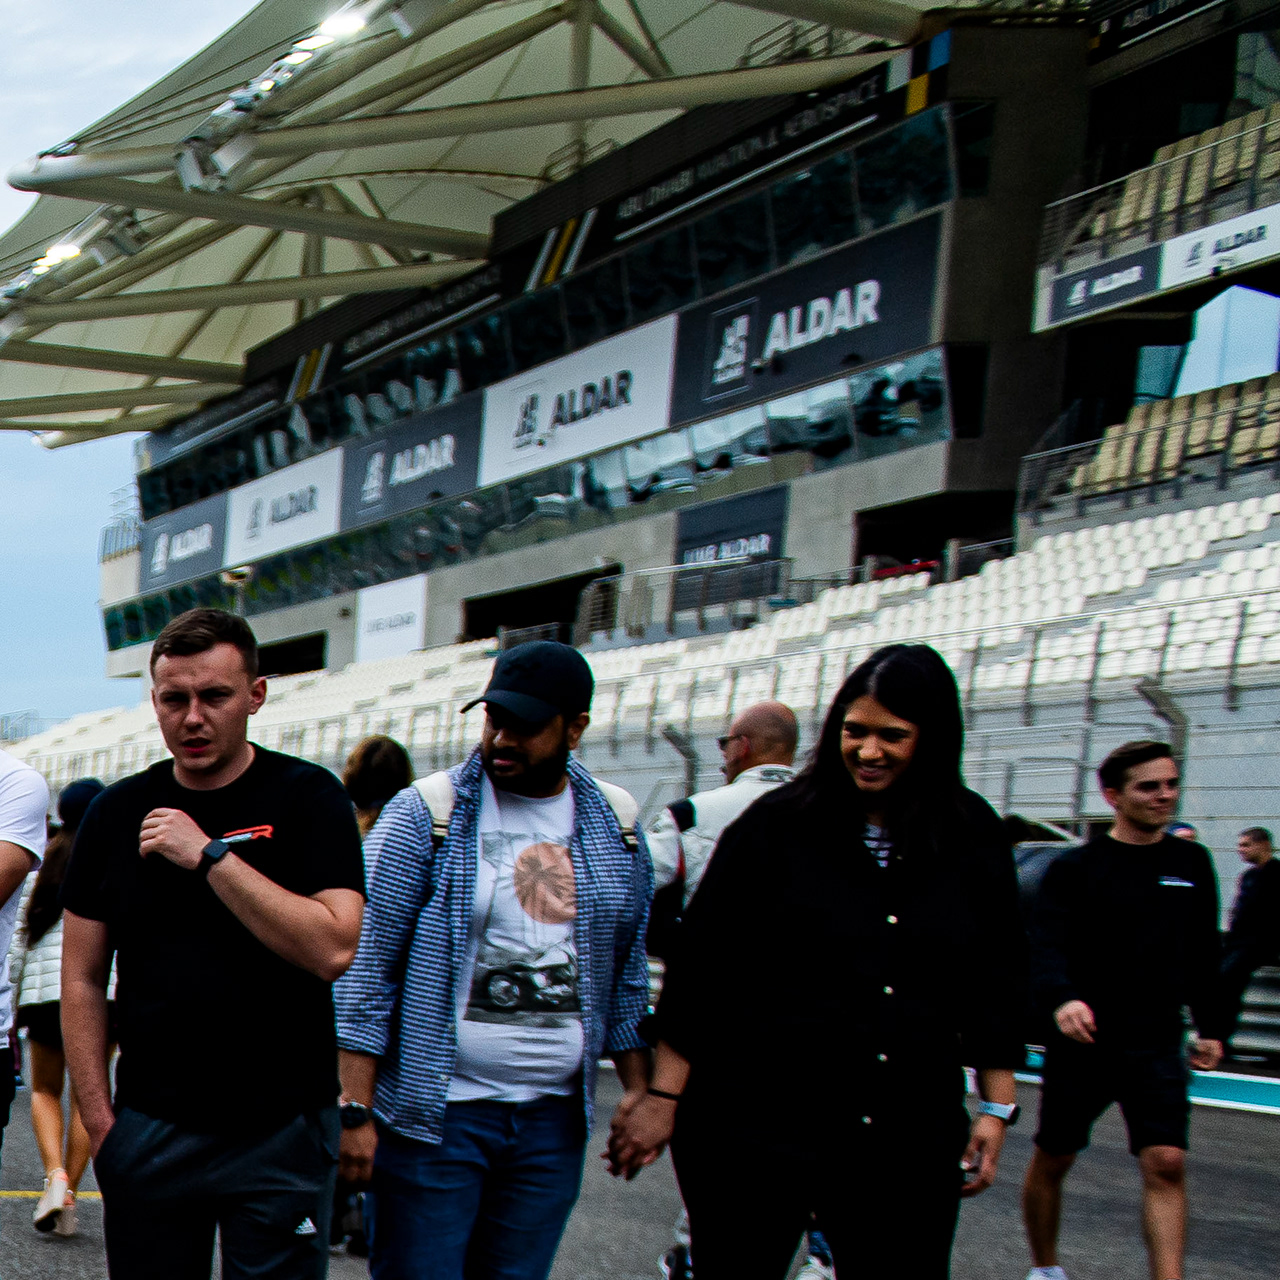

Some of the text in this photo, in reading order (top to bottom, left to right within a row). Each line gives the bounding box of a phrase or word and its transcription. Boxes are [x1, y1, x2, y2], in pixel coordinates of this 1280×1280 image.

[760, 279, 881, 363] ALDAR
[549, 369, 633, 430] ALDAR
[389, 434, 457, 486] ALDAR
[719, 534, 771, 560] ALDAR
